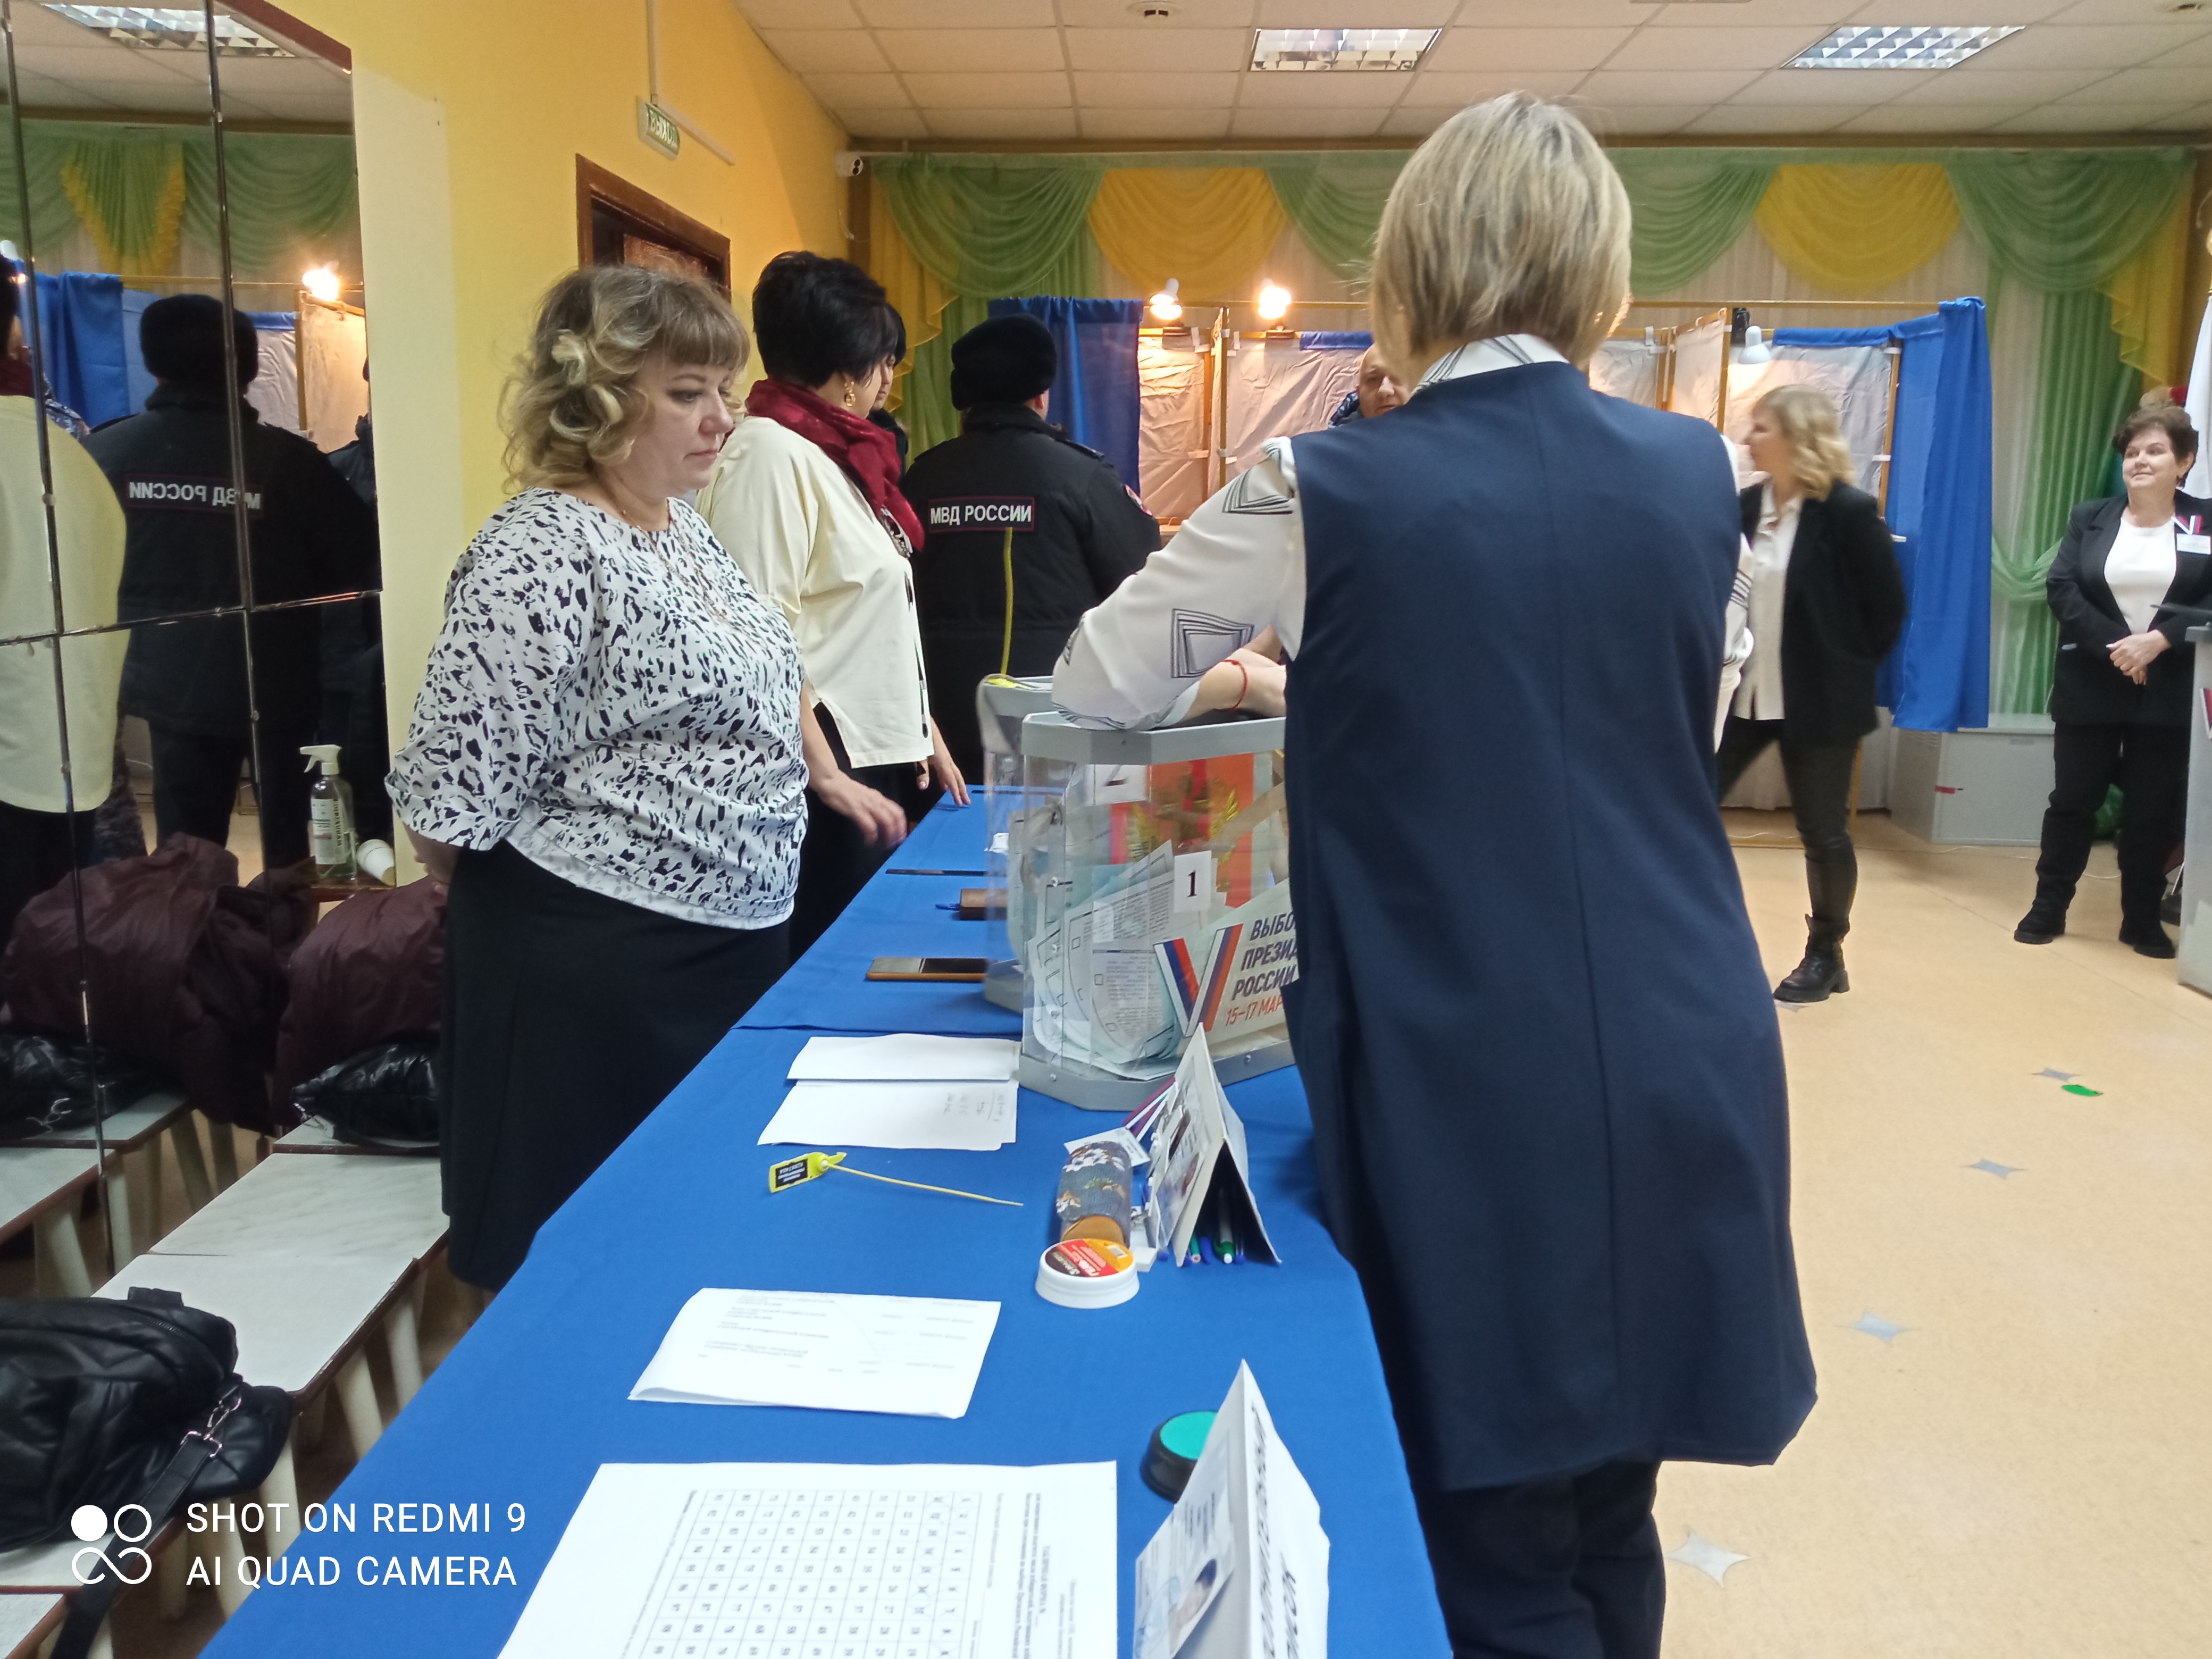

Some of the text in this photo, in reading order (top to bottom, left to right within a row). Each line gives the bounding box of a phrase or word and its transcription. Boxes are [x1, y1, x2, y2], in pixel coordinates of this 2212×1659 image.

[931, 504, 1032, 526] МВД РОССИИ
[1186, 870, 1197, 898] 1
[1231, 963, 1297, 1001] РОССИИ
